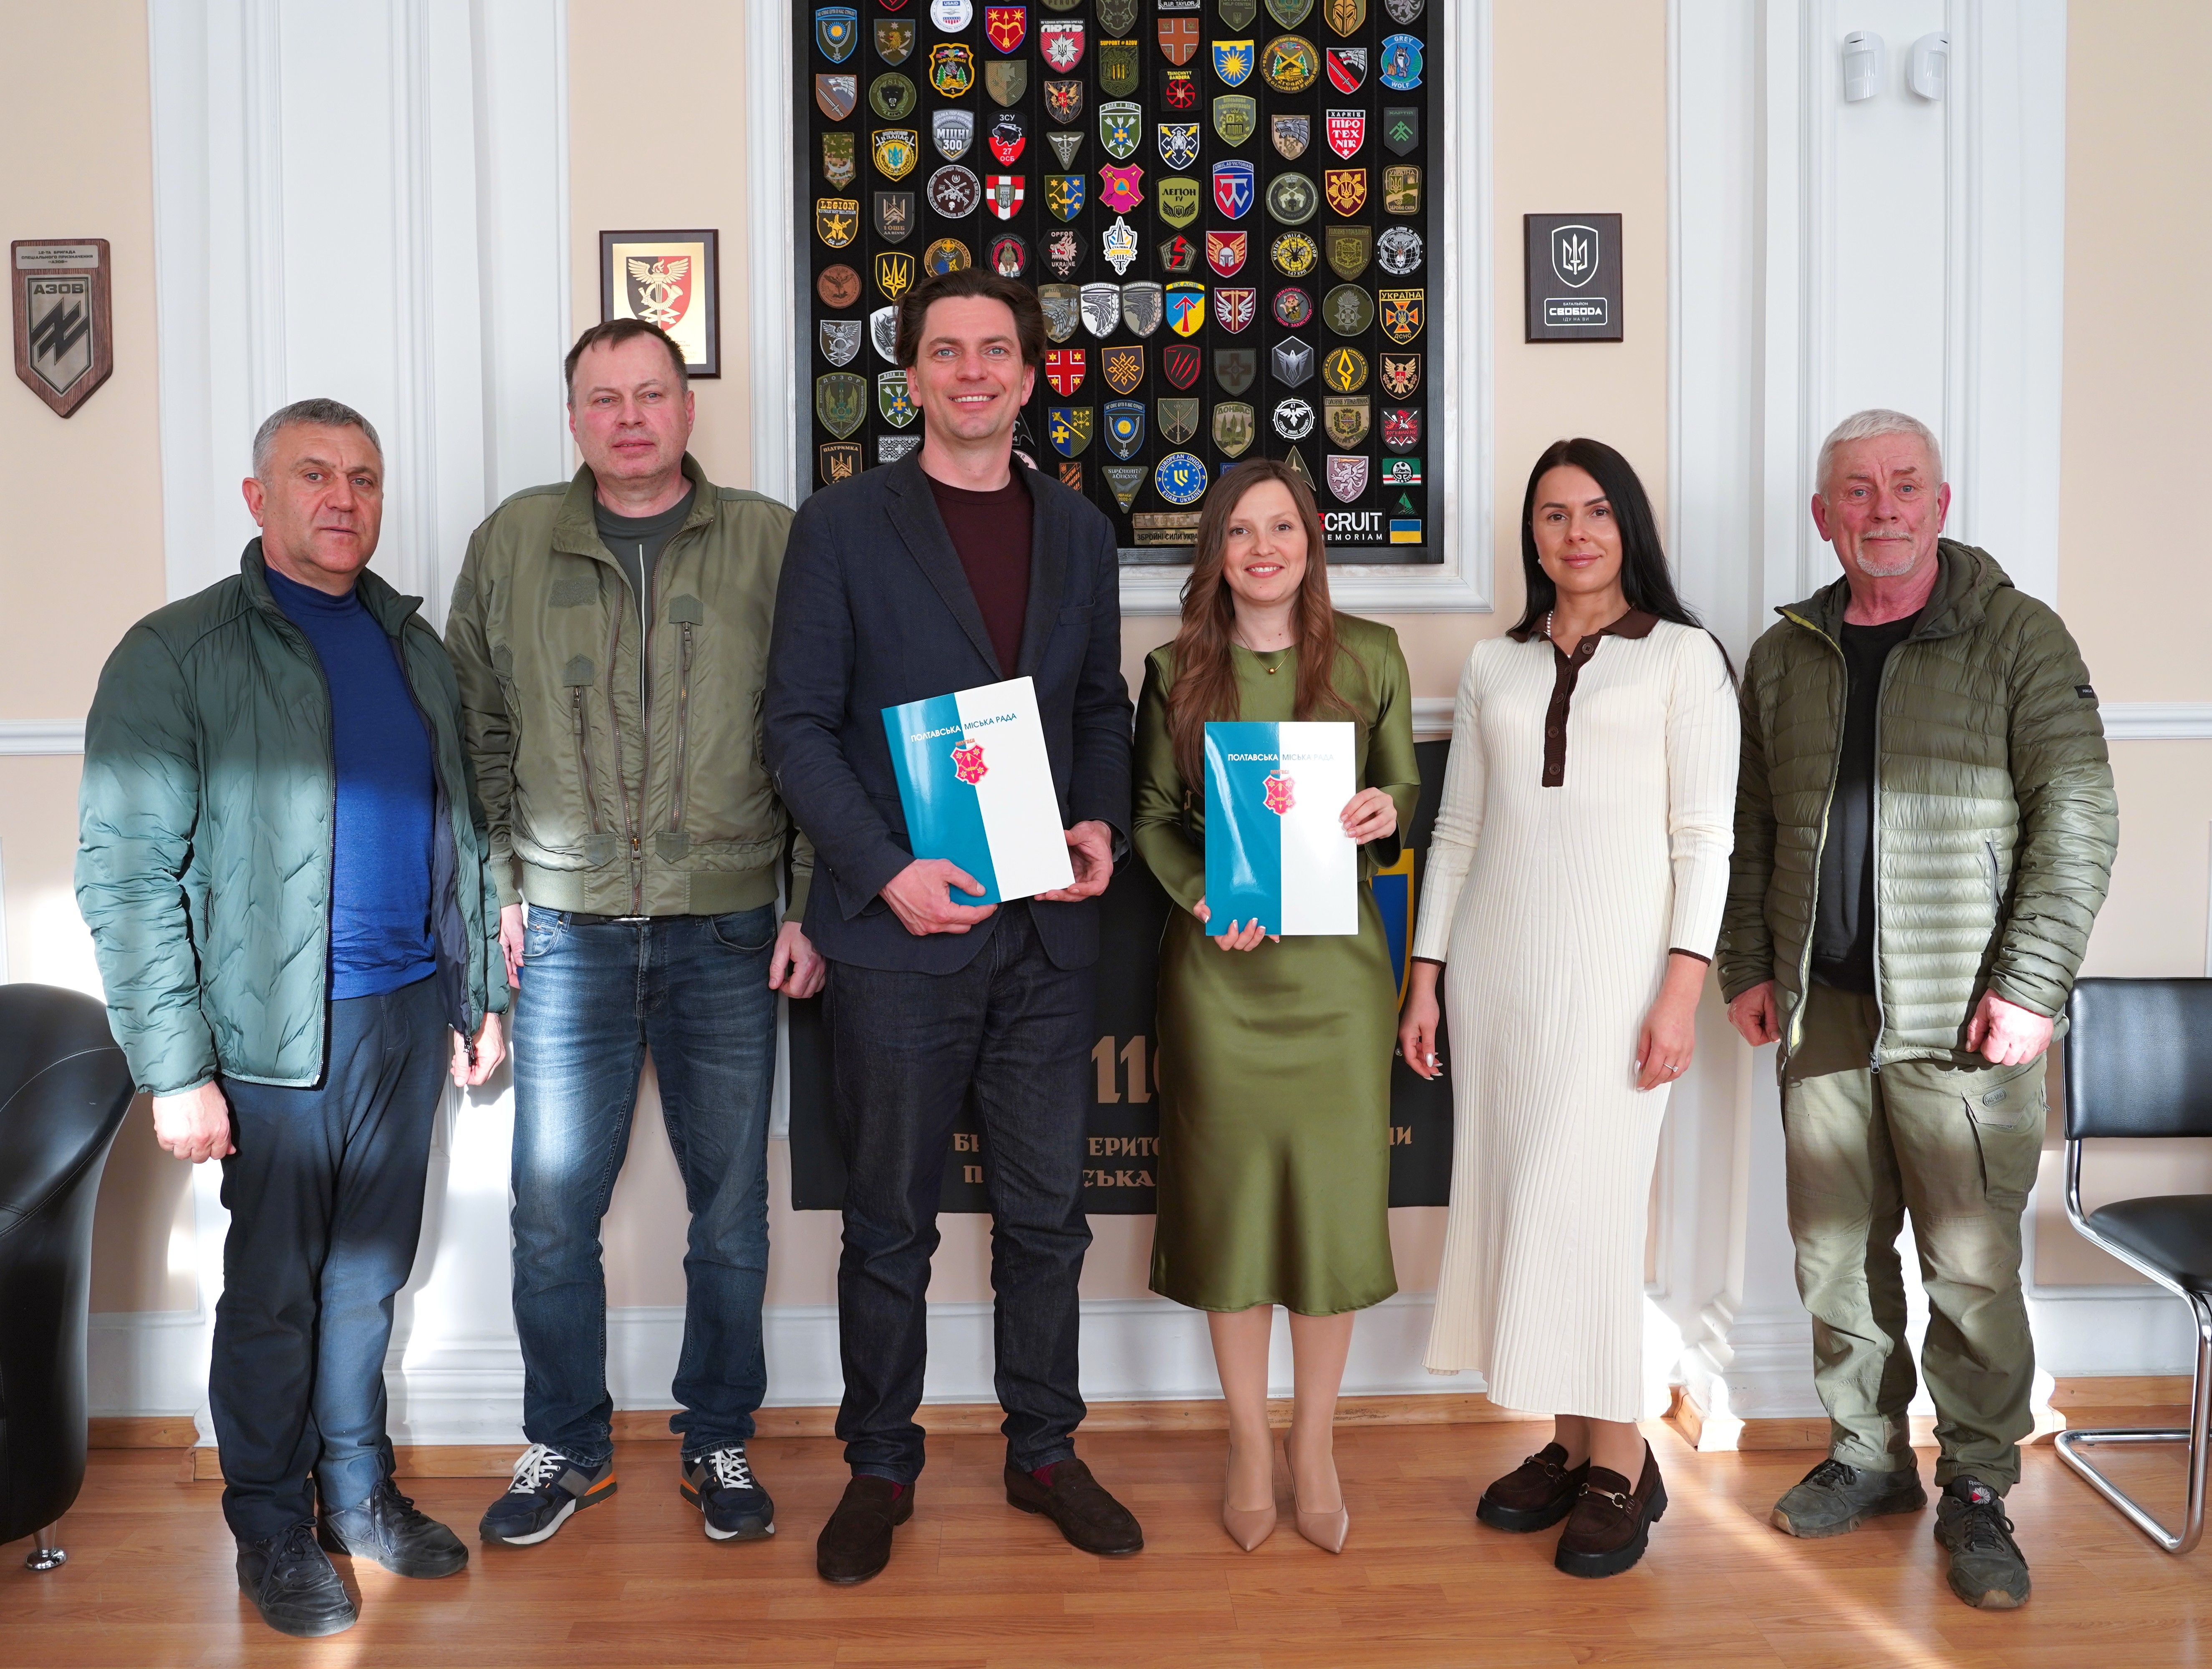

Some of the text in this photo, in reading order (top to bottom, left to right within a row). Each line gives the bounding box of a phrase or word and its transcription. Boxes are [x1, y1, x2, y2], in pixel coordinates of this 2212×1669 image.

[1041, 24, 1084, 33] ЛЮТЬ
[936, 128, 969, 141] МІЦНІ
[943, 139, 962, 150] 300
[1162, 188, 1196, 197] ЛЕГІОН
[820, 201, 855, 210] LEGION
[1273, 240, 1281, 261] VIRTUS
[33, 284, 83, 295] АЗОВ
[1382, 291, 1422, 300] УКРАЇНА
[1549, 307, 1602, 316] СВОБОДА
[1347, 348, 1364, 361] ACHILLES
[823, 375, 861, 384] ДОЗОР
[1217, 406, 1251, 415] ДОНБАС
[1279, 420, 1288, 432] STRIKE
[1299, 419, 1309, 434] COMPANY
[1159, 454, 1203, 471] EUROPEAN UNION
[1162, 488, 1203, 503] EUAM UKRAINE
[911, 713, 1017, 743] ПОЛТАВСЬКА МІСЬКА РАДА
[1091, 1035, 1159, 1104] 11
